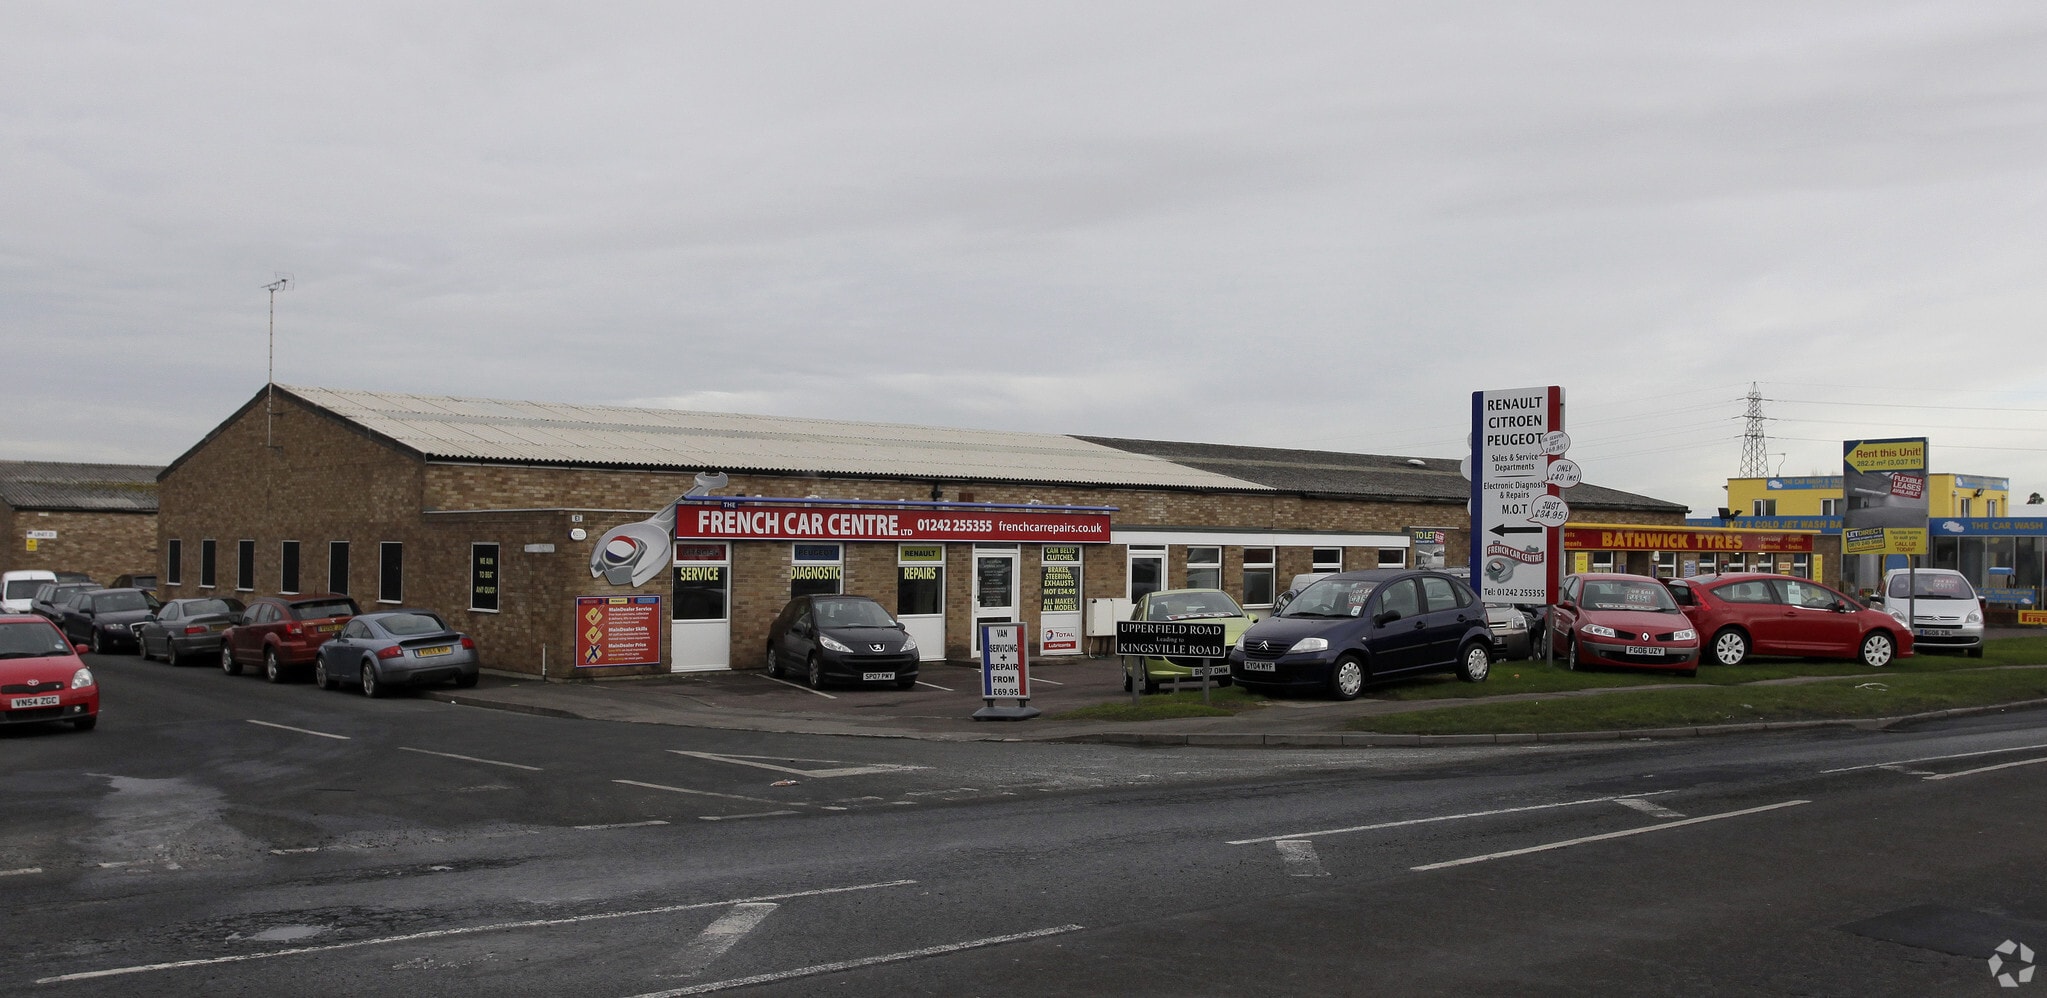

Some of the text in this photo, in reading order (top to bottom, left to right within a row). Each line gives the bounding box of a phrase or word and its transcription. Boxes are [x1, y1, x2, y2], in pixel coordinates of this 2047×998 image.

[1487, 397, 1543, 411] RENAULT
[1488, 415, 1542, 428] CITROEN
[1487, 433, 1544, 446] PEUGEOT
[1492, 454, 1508, 462] Sales
[1516, 453, 1538, 461] Service
[1856, 448, 1921, 458] Rent this Unit!
[1495, 463, 1535, 472] Departments
[1556, 464, 1573, 472] ONLY
[1550, 473, 1580, 481] £40 inc!
[1894, 475, 1922, 485] FLEXIBLE
[1483, 481, 1546, 490] Electronic Diagnosis
[1893, 482, 1921, 492] LEASES
[1505, 491, 1530, 500] Repairs
[1502, 504, 1528, 514] M.O.T
[1542, 501, 1561, 510] JUST
[1535, 510, 1567, 520] £34.95!
[698, 510, 779, 534] FRENCH
[783, 512, 823, 535] CAR
[827, 513, 899, 536] CENTRE
[917, 518, 951, 532] 01242
[953, 519, 993, 532] 255355
[998, 521, 1102, 534] frenchcarrepairs.co.uk
[1746, 520, 1752, 528] &
[1755, 521, 1779, 529] COLD
[1781, 521, 1796, 529] JET
[1801, 521, 1827, 529] WASH
[1415, 531, 1424, 539] TO
[1424, 531, 1436, 539] LET
[1601, 532, 1743, 549] BATHWICK TYRES
[1487, 546, 1543, 562] FRENCH CAR CENTRE
[680, 567, 719, 581] SERVICE
[904, 567, 936, 580] REPAIRS
[484, 586, 495, 594] QUOT
[1484, 588, 1545, 597] Tel: 01242 255355
[996, 629, 1008, 638] VAN
[1121, 623, 1222, 635] UPPERFIELD ROAD
[989, 644, 1018, 653] SERVICING
[1120, 643, 1221, 655] KINGSVILLE ROAD
[1195, 667, 1212, 675] BK7
[993, 688, 1019, 696] £69.95
[16, 696, 57, 707] VN54 ZGC
